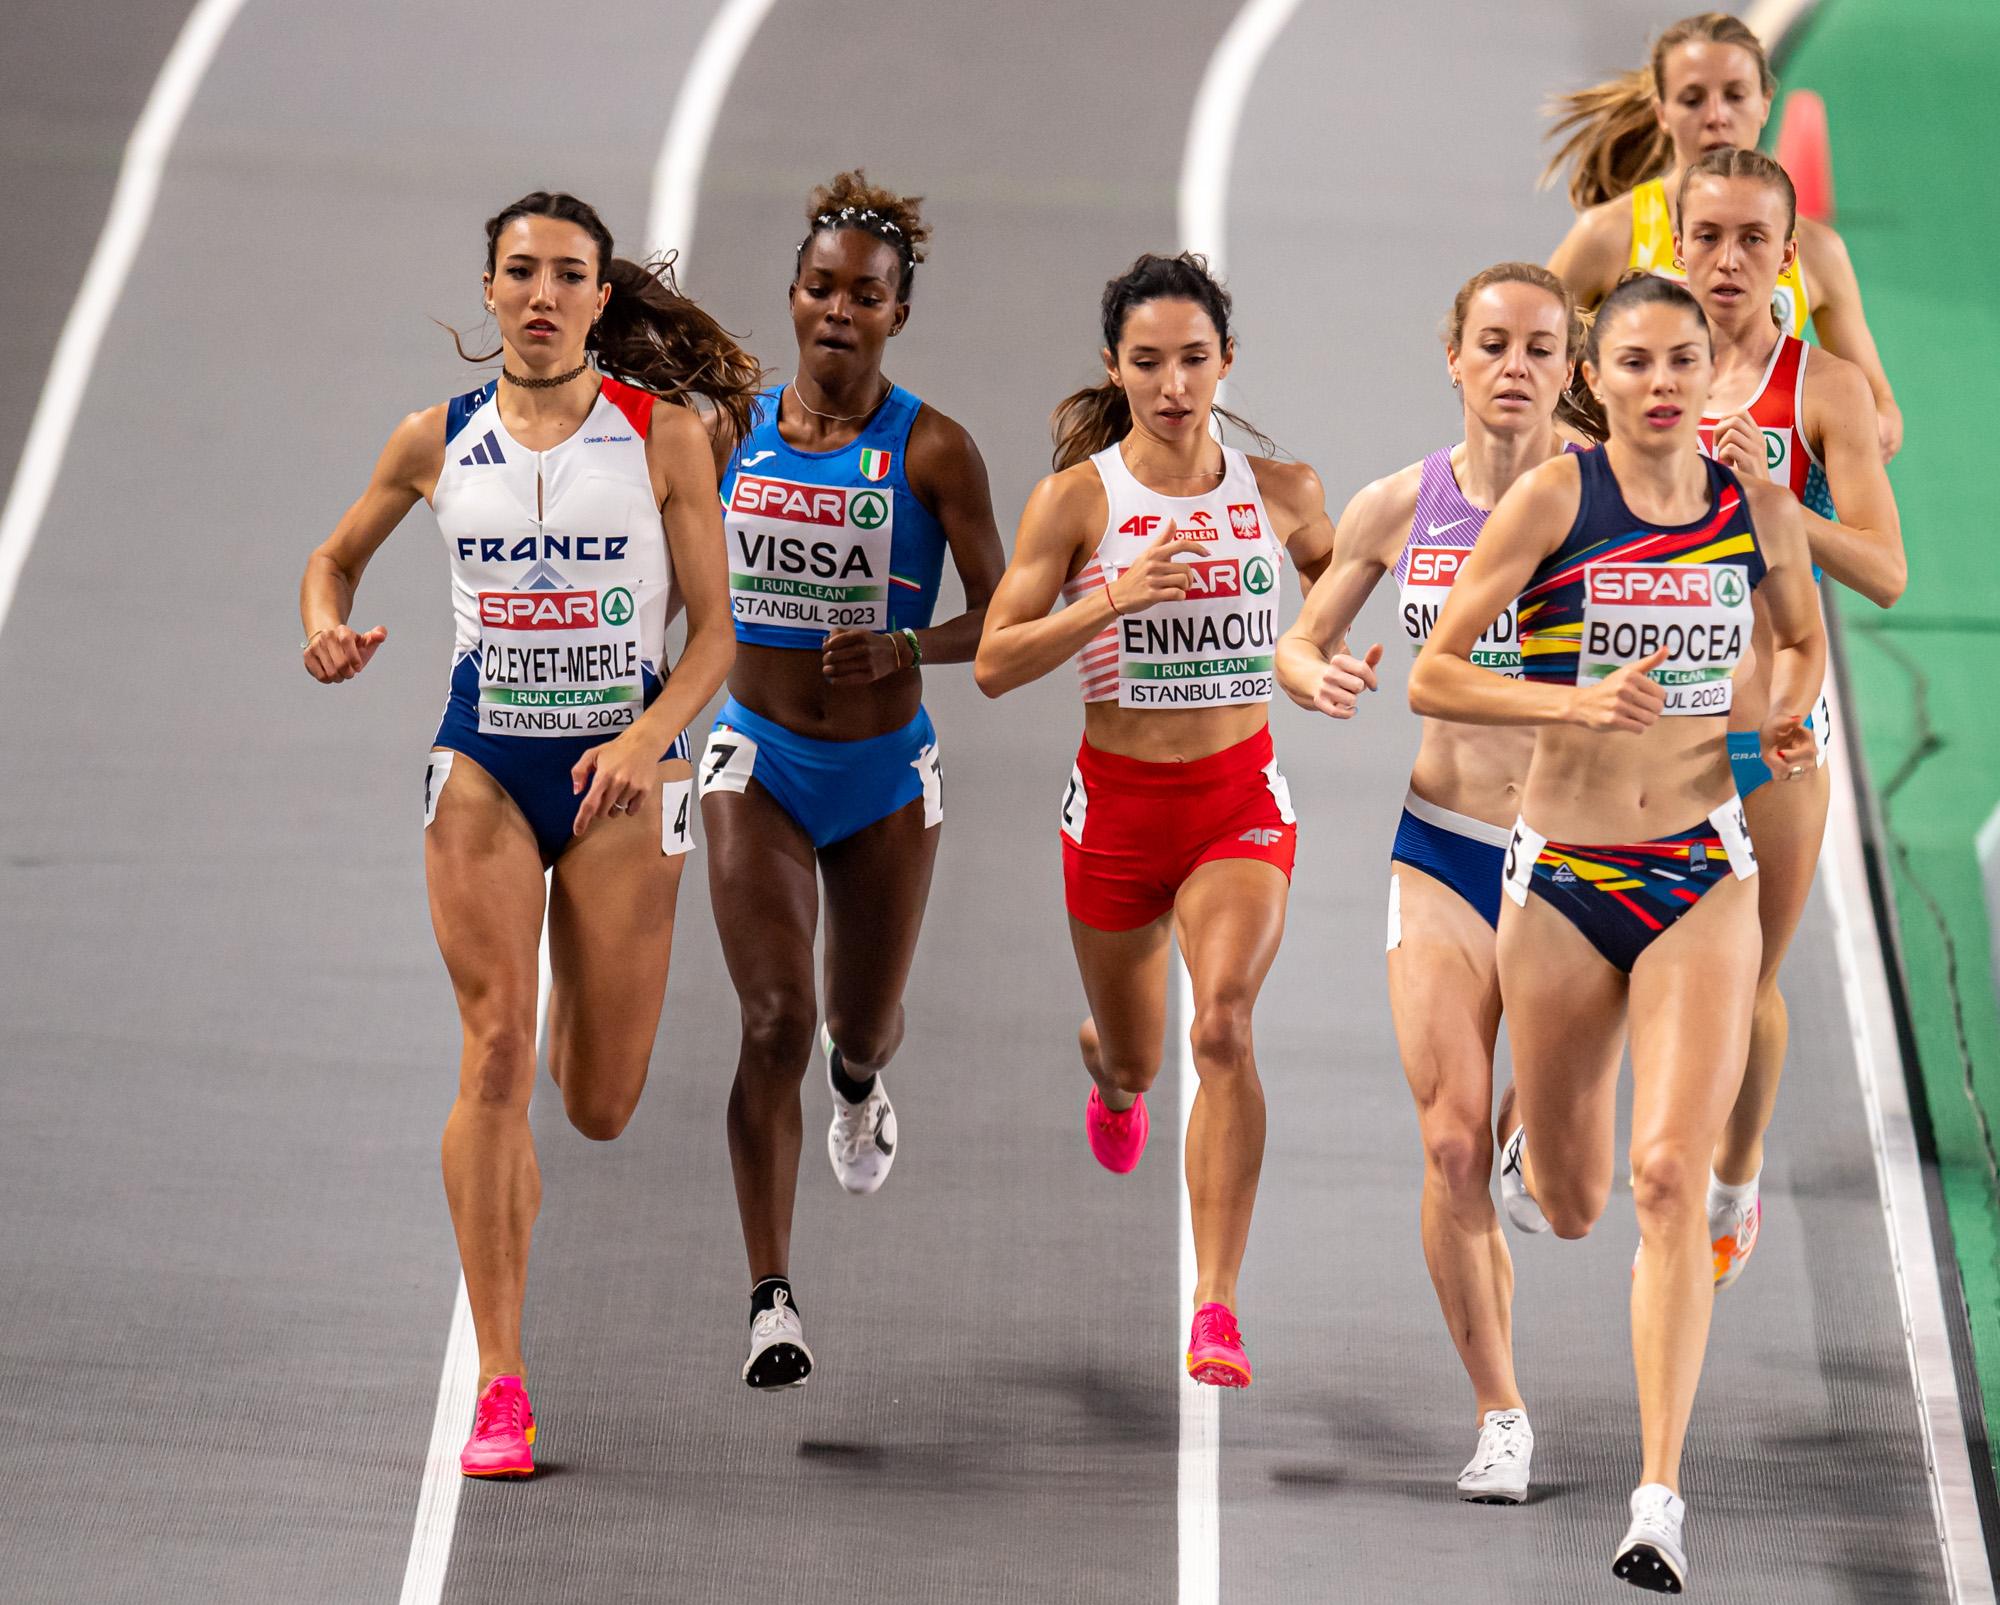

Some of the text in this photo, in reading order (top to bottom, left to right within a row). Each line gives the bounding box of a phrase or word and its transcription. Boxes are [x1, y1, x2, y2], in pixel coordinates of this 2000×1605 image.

[735, 481, 842, 521] SPAR
[457, 535, 629, 562] FRANCE
[1175, 530, 1216, 540] ORLEN
[737, 531, 874, 579] VISSA
[754, 578, 758, 590] I
[762, 579, 794, 594] RUN
[1593, 572, 1709, 601] SPAR
[482, 596, 595, 626] SPAR
[733, 596, 875, 625] STANBUL 2023
[1122, 609, 1274, 654] ENNAOUI
[1588, 621, 1741, 662] BOBOCEA
[485, 641, 636, 683] CLEYET-MERLE
[1154, 664, 1158, 676] I
[1162, 661, 1196, 676] RUN
[517, 691, 550, 704] RUN
[1131, 683, 1227, 702] ISTANBUL
[1691, 686, 1726, 708] 2023
[489, 708, 634, 730] ISTANBUL 2023
[704, 744, 738, 786] 7
[674, 792, 689, 843] 4
[1551, 875, 1577, 883] PEAK
